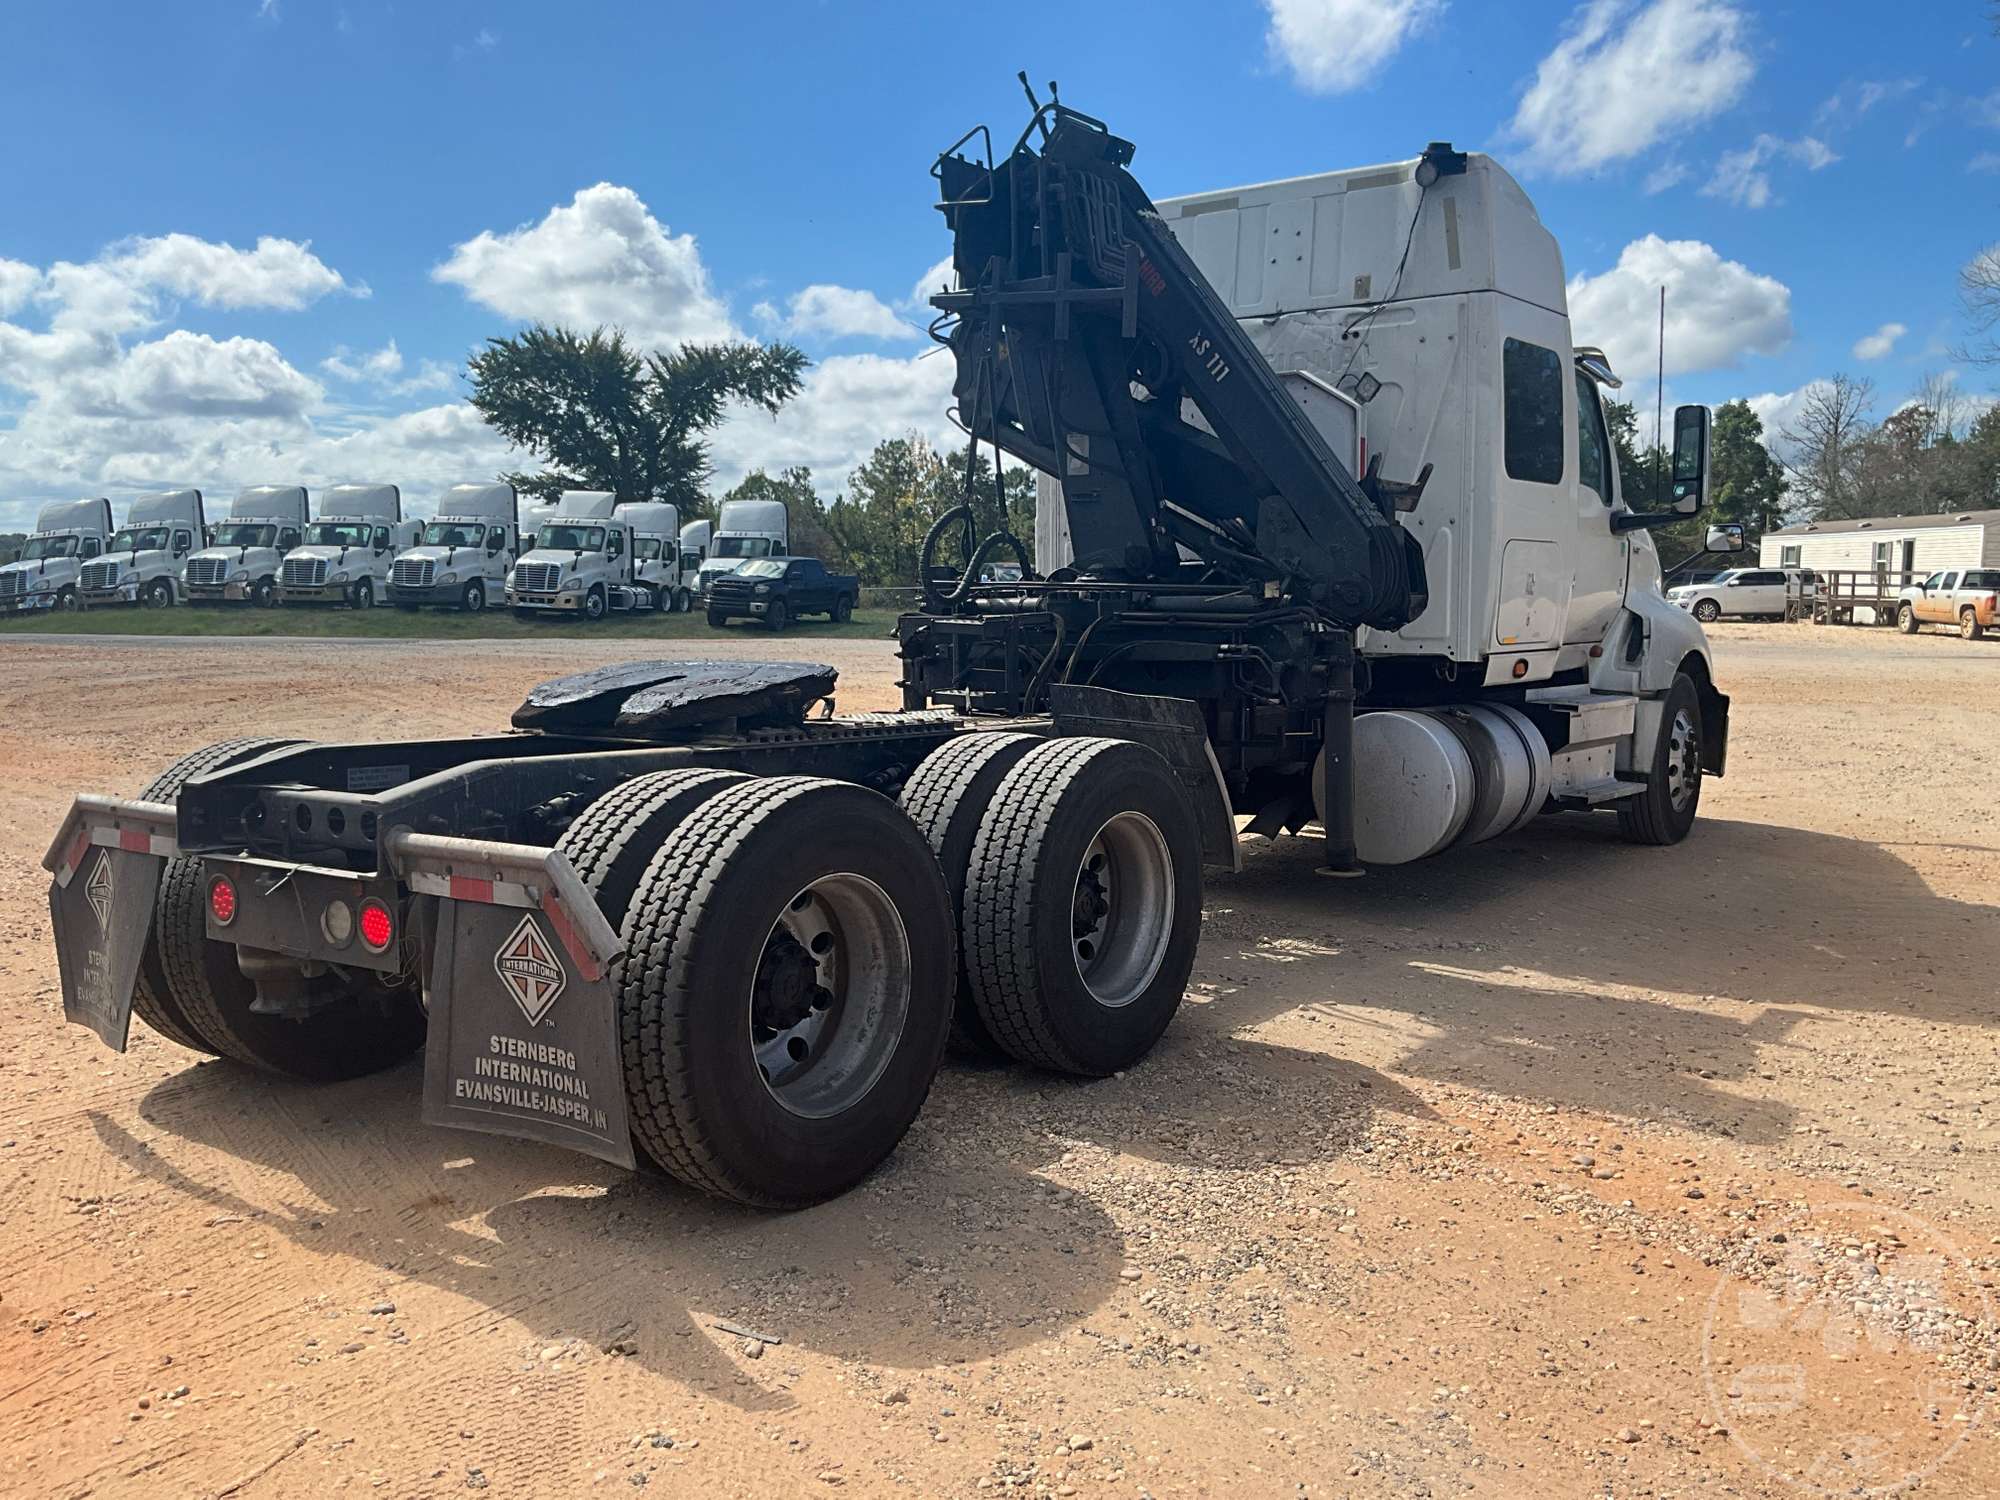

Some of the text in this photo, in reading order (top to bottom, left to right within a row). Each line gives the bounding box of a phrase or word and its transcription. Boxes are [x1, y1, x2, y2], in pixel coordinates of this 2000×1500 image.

[502, 959, 558, 979] INTERNATIONAL
[489, 1034, 577, 1071] STERNBERG
[475, 1056, 590, 1100] INTERNATIONAL
[455, 1078, 608, 1131] EVANSVILLE-JASPER, IN
